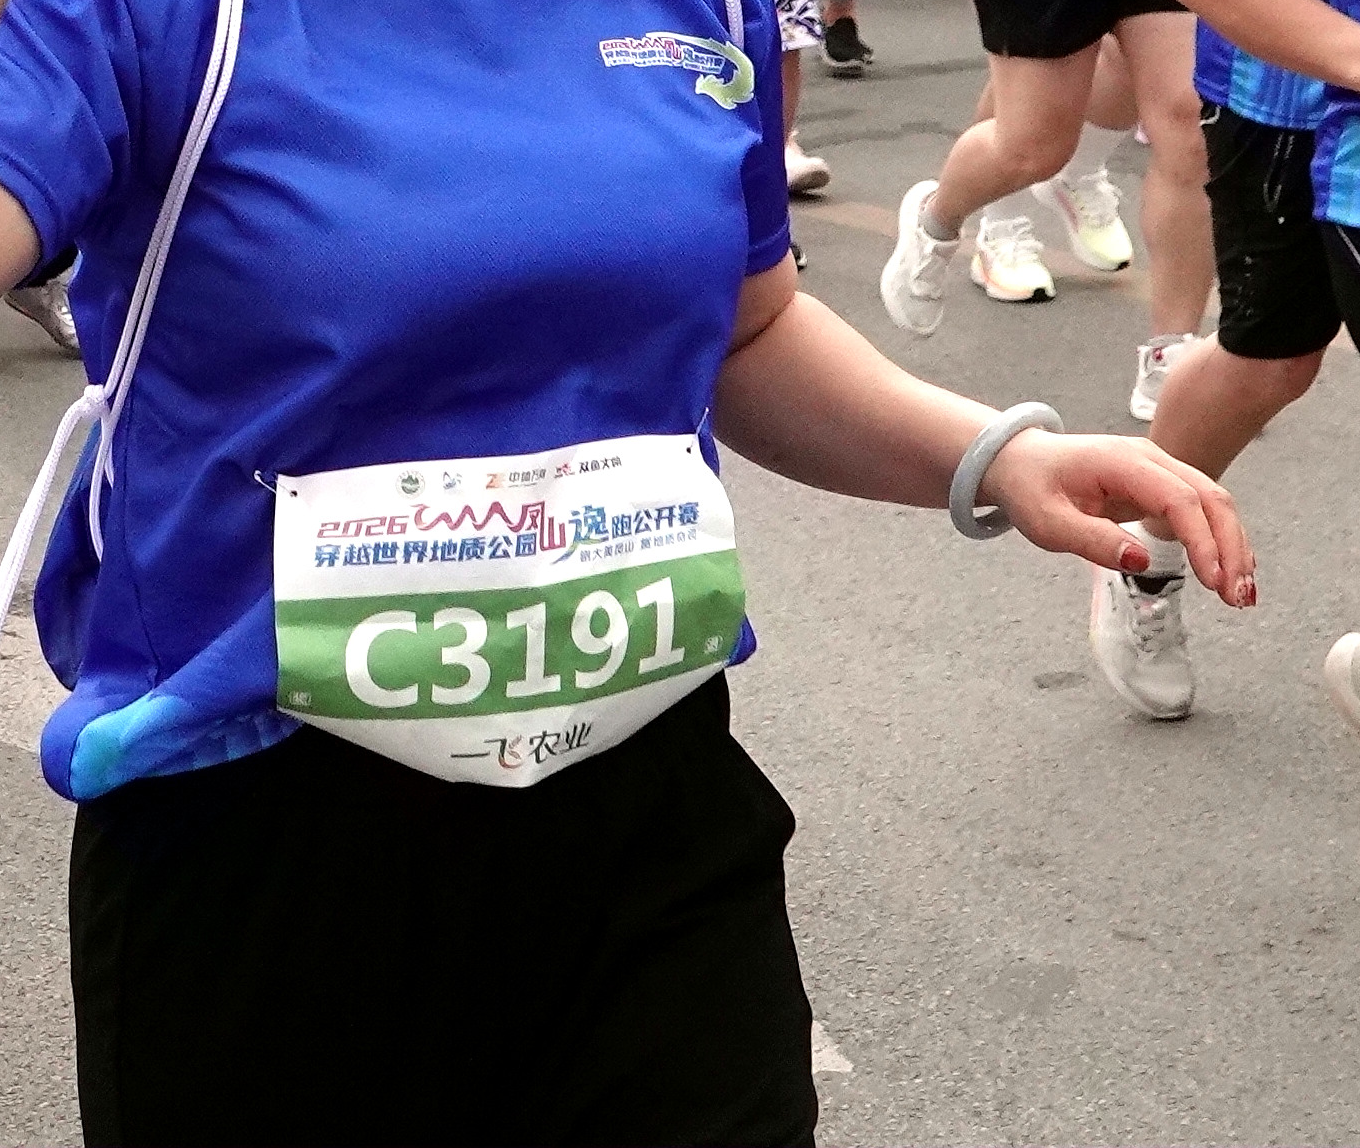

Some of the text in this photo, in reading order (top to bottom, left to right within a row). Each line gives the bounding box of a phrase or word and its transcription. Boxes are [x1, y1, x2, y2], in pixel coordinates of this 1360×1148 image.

[316, 515, 410, 539] 2026
[568, 501, 700, 543] 逸跑公开赛
[315, 532, 537, 568] 穿越世界地质公园
[345, 576, 686, 710] C3191
[449, 721, 593, 770] 一飞农业
